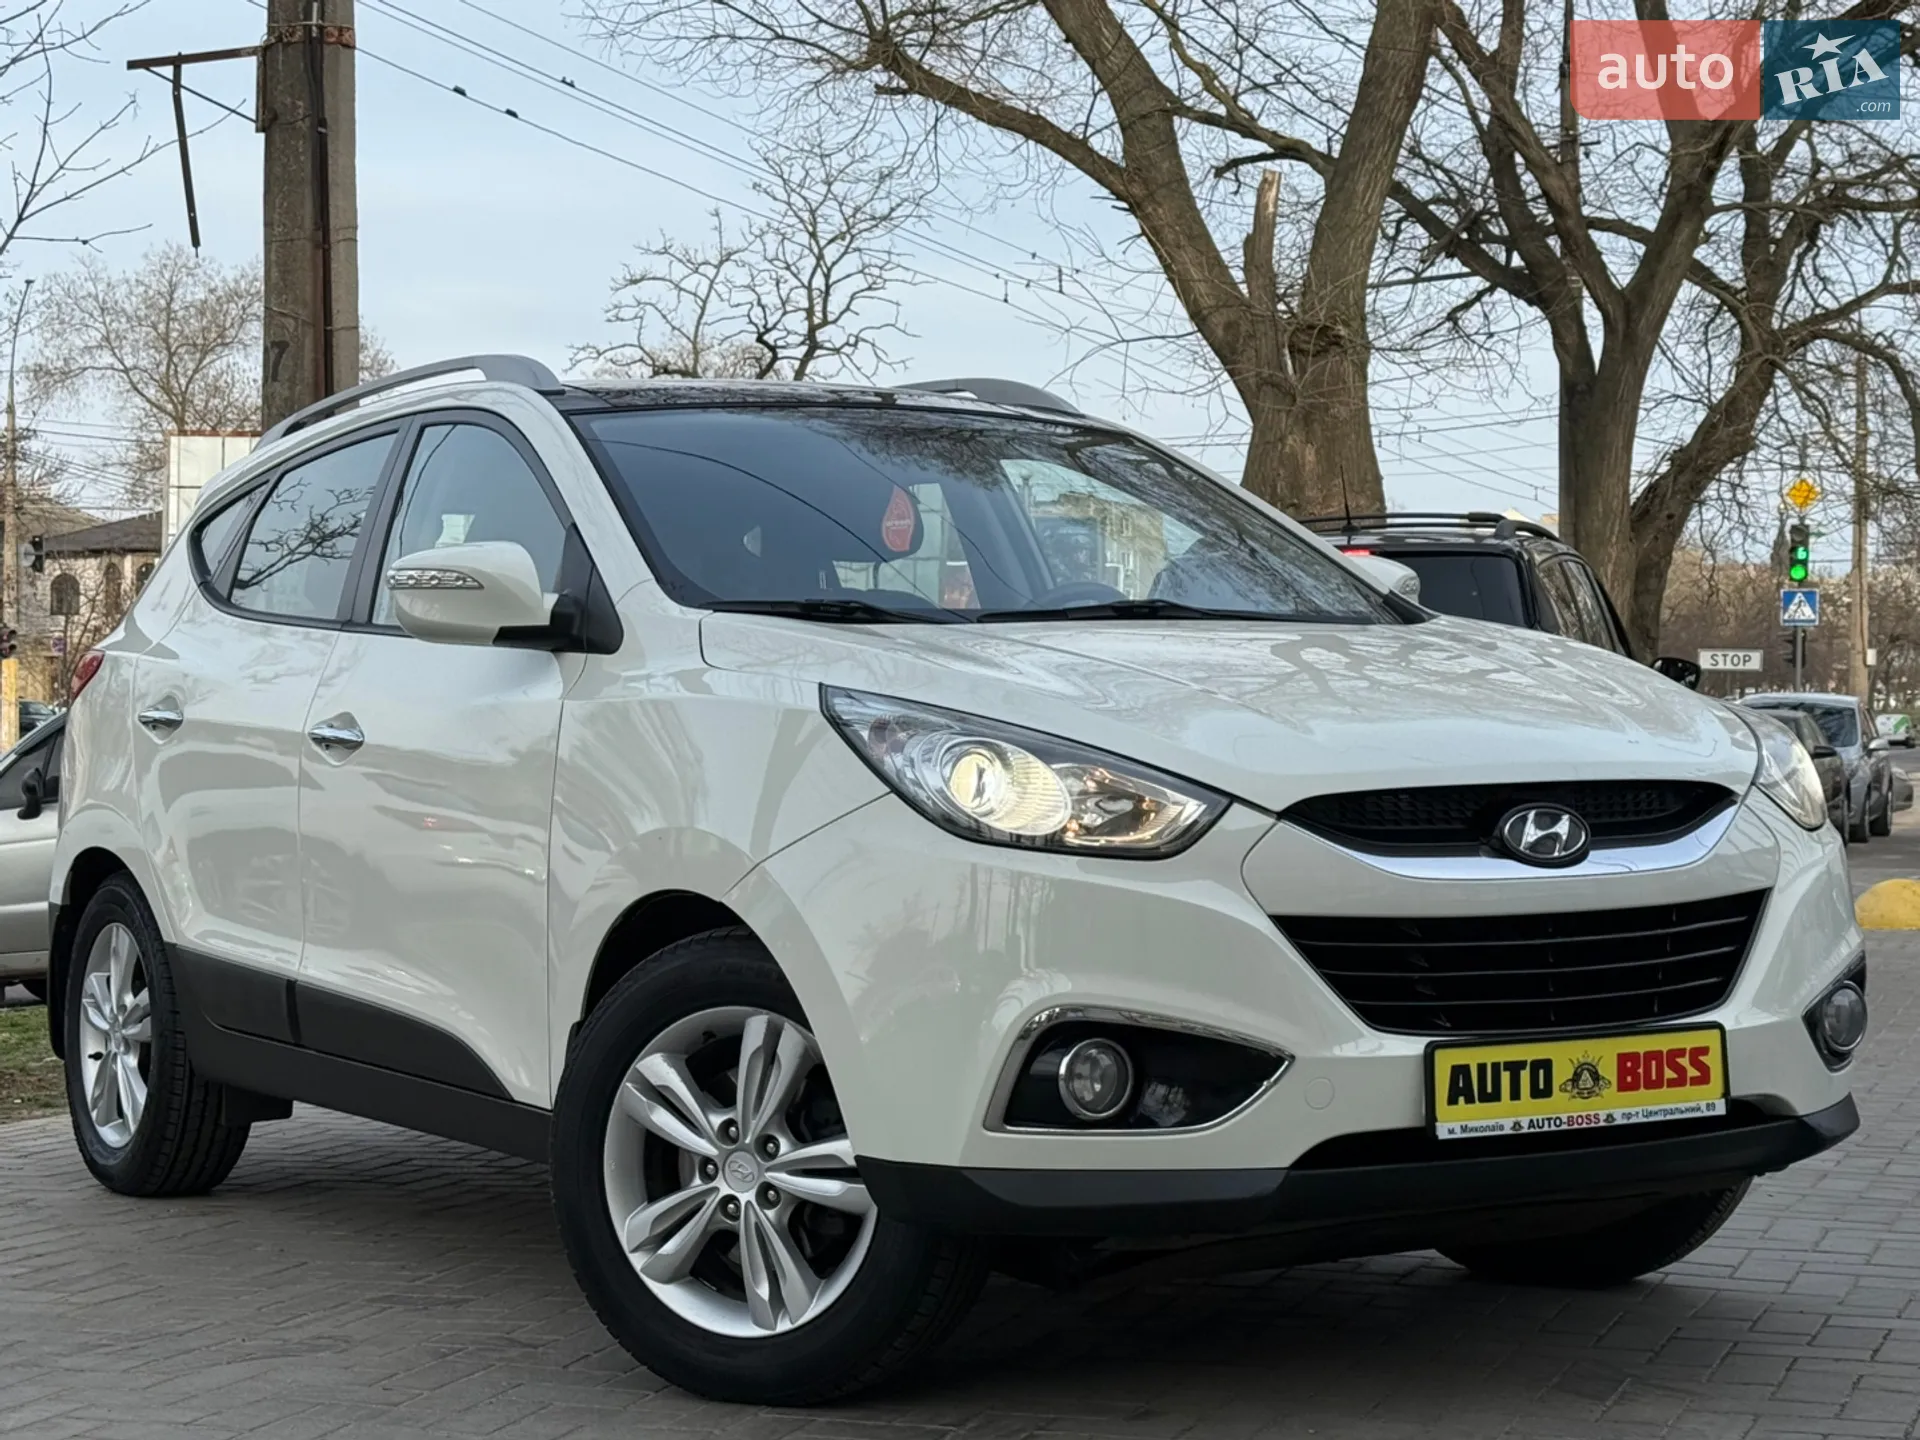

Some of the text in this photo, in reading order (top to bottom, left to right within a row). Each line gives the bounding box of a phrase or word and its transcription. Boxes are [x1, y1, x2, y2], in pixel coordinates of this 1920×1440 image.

[1710, 653, 1752, 667] STOP
[1446, 1046, 1710, 1106] AUTO BOSS
[1460, 1122, 1505, 1134] Миколаїв
[1527, 1113, 1601, 1130] AUTO-BOSS
